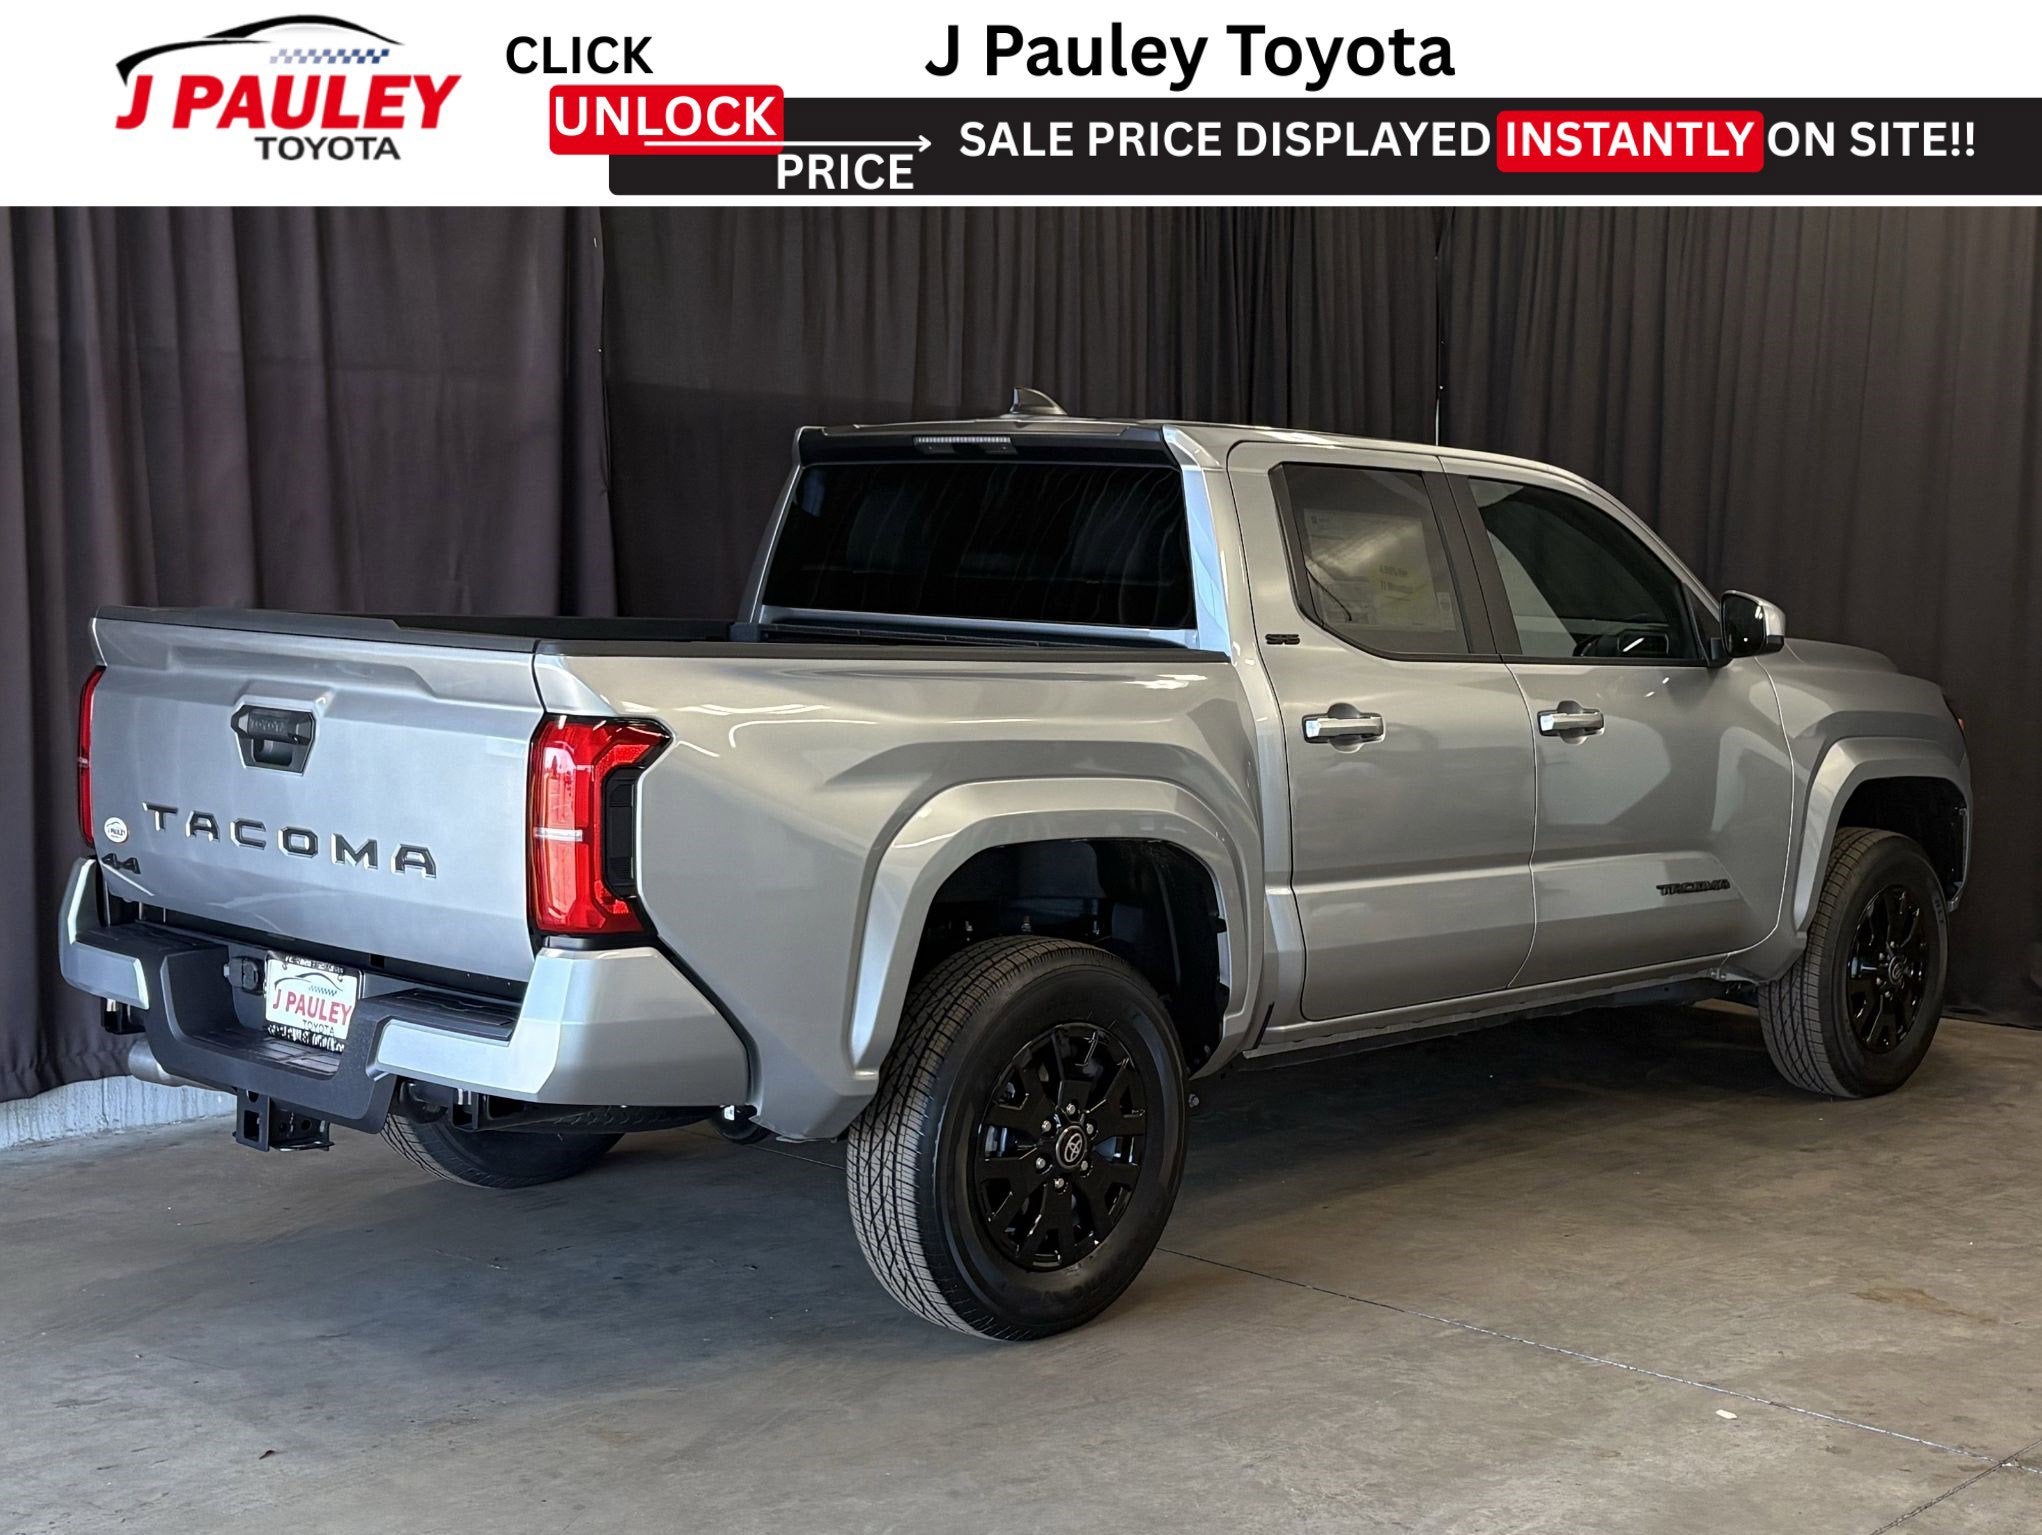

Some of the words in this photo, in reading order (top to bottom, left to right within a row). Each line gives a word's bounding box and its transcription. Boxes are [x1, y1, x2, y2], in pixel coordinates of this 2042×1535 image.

[142, 802, 436, 878] TACOMA
[273, 989, 282, 1009] J
[285, 991, 352, 1025] PAULEY
[303, 1019, 335, 1035] TOYOTA
